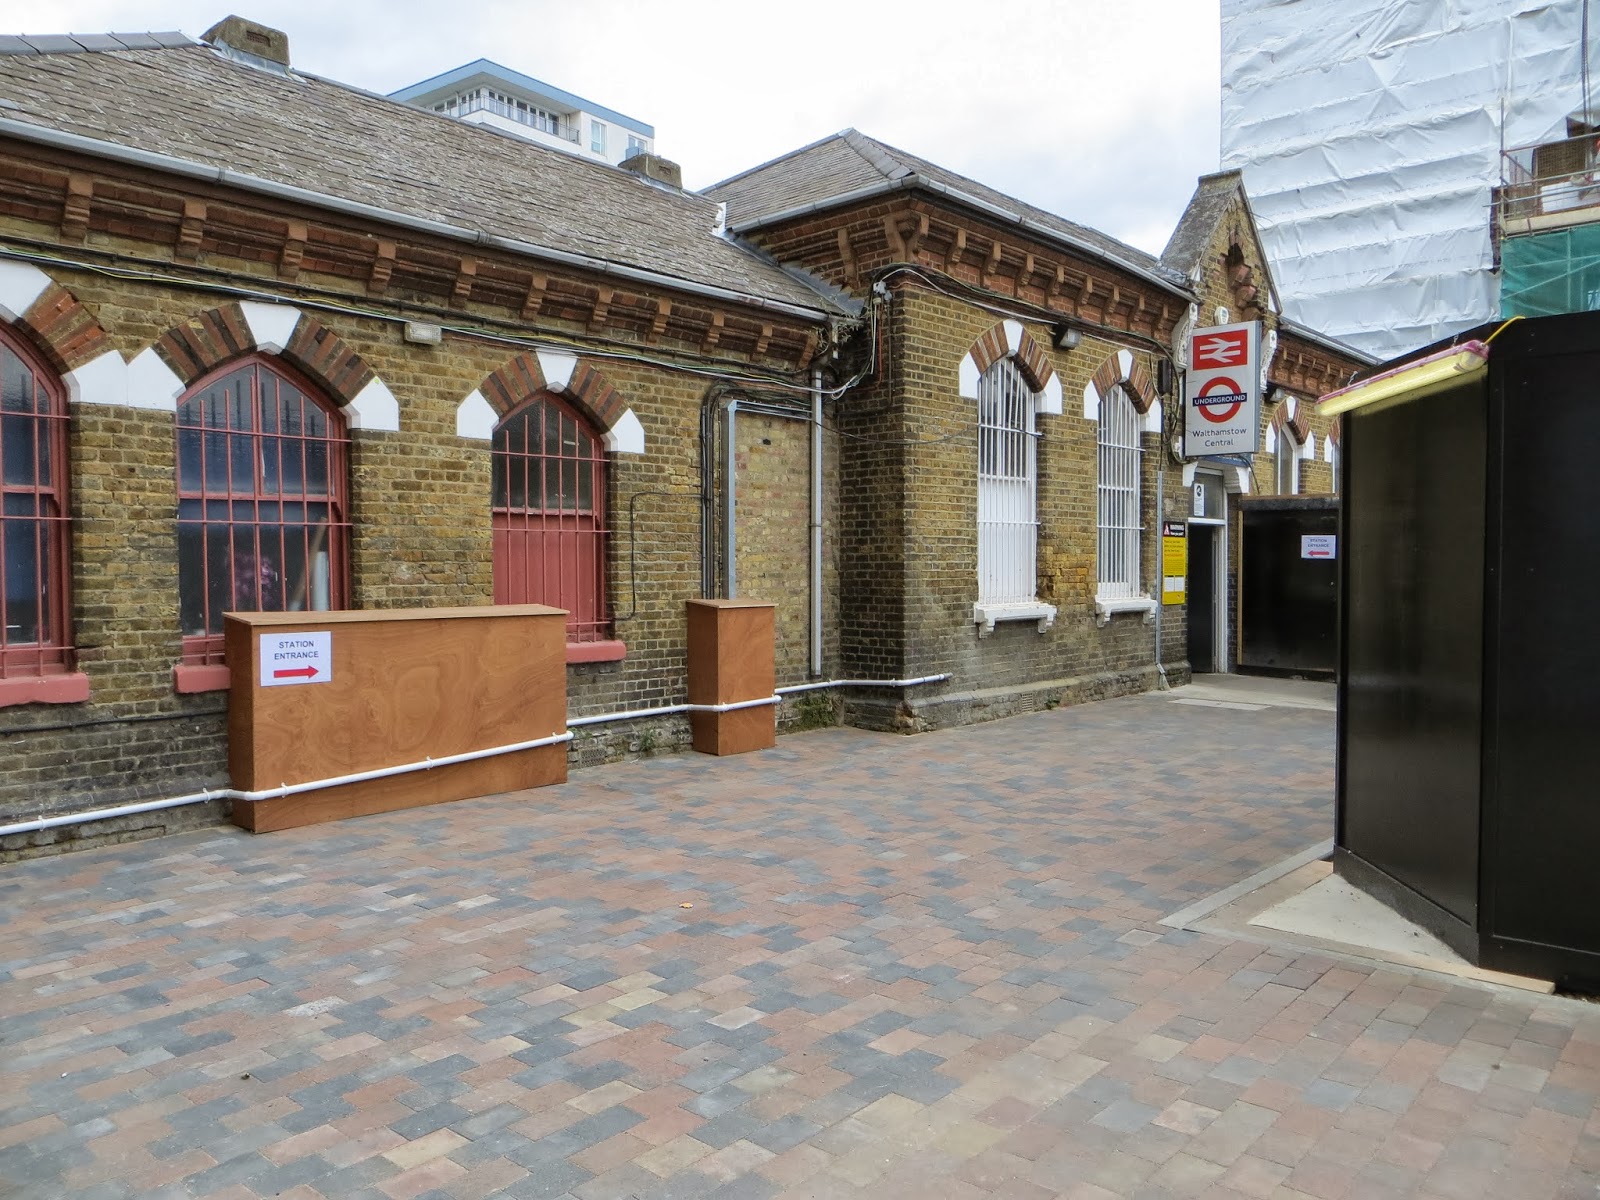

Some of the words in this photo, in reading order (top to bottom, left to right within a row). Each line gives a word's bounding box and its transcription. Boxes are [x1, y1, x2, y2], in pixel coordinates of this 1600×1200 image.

[1194, 395, 1246, 405] UNDERGROUND
[1192, 428, 1247, 437] Walthamstow
[1204, 439, 1234, 447] Central
[279, 640, 314, 649] STATION
[274, 651, 319, 660] ENTRANCE
